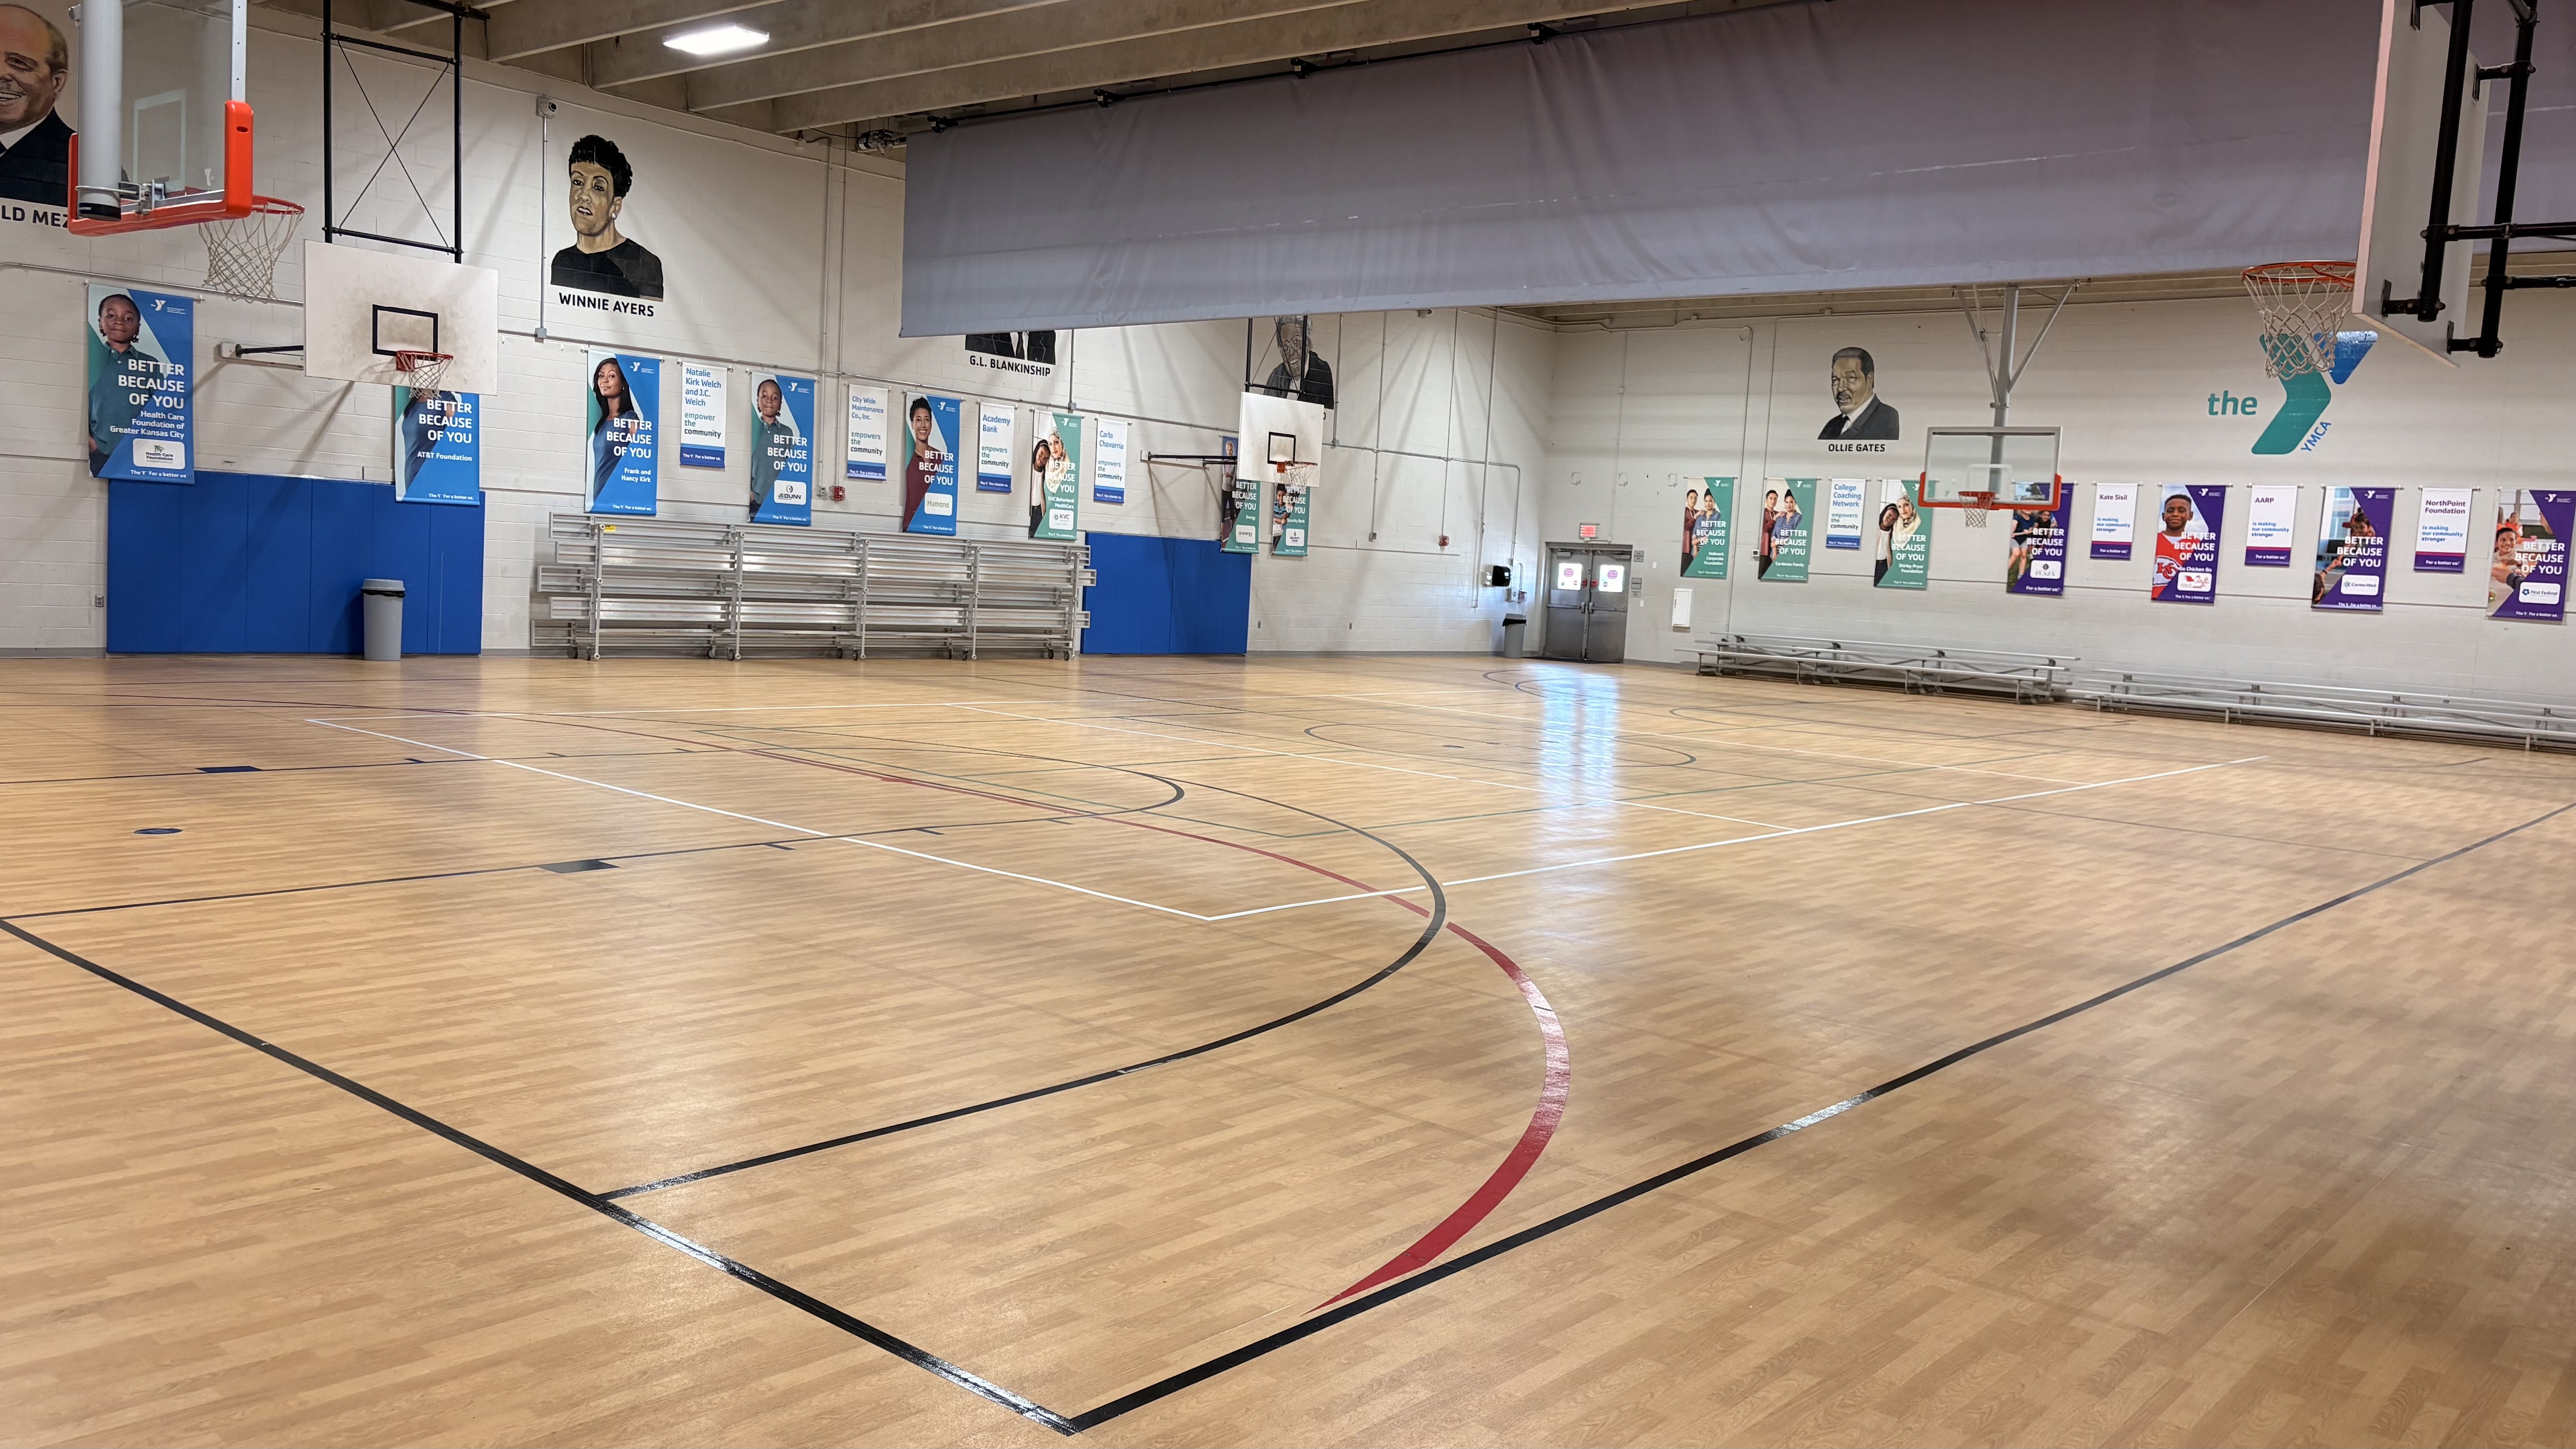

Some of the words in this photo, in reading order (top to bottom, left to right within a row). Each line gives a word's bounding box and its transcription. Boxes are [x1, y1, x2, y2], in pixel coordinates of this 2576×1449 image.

[559, 292, 609, 310] WINNIE
[613, 300, 654, 317] AYERS
[129, 359, 184, 376] BETTER
[970, 355, 987, 367] G.L.
[990, 359, 1050, 377] BLANKINSHIP
[686, 368, 710, 377] Natalie
[118, 375, 184, 392] BECAUSE
[686, 377, 699, 386] Kirk
[701, 379, 721, 388] Welch
[129, 393, 149, 405] OF
[152, 395, 184, 409] YOU
[685, 397, 705, 406] Welch
[2208, 390, 2257, 415] the
[427, 399, 472, 414] BETTER
[852, 404, 884, 414] Maintenance
[419, 414, 472, 428] BECAUSE
[685, 413, 715, 421] empower
[983, 414, 1010, 426] Academy
[132, 419, 175, 428] Foundation
[614, 418, 652, 430] BETTER
[983, 424, 998, 433] Bank
[110, 426, 139, 434] Greater
[141, 428, 168, 437] Kansas
[170, 431, 184, 440] City
[428, 430, 443, 441] OF
[446, 432, 472, 444] YOU
[685, 428, 721, 439] community
[2300, 421, 2332, 451] YMCA
[607, 432, 652, 445] BECAUSE
[773, 434, 807, 446] BETTER
[613, 446, 627, 456] OF
[630, 447, 651, 459] YOU
[851, 447, 883, 456] community
[1856, 444, 1885, 452] GATES
[436, 453, 472, 461] Foundation
[768, 447, 807, 460] BECAUSE
[925, 450, 954, 461] BETTER
[773, 461, 786, 470] OF
[788, 462, 807, 473] YOU
[919, 462, 953, 474] BECAUSE
[981, 459, 1009, 468] community
[1050, 461, 1075, 471] BETTER
[925, 475, 934, 483] OF
[937, 476, 953, 486] YOU
[1236, 481, 1257, 490] BETTER
[1060, 484, 1074, 493] YOU
[1834, 483, 1856, 492] College
[1232, 491, 1256, 500] BECAUSE
[1283, 496, 1306, 504] BECAUSE
[1834, 492, 1861, 501] Coaching
[1780, 529, 1807, 537] BETTER
[2033, 528, 2064, 536] BETTER
[2027, 538, 2063, 546] BECAUSE
[2345, 536, 2383, 546] BETTER
[2174, 543, 2215, 551] BECAUSE
[2524, 542, 2565, 551] BETTER
[2194, 553, 2213, 561] YOU
[2337, 547, 2383, 557] BECAUSE
[2343, 558, 2356, 567] OF
[2359, 559, 2381, 568] YOU
[2515, 553, 2564, 563] BECAUSE
[2521, 565, 2536, 573] OF
[2539, 566, 2562, 575] YOU
